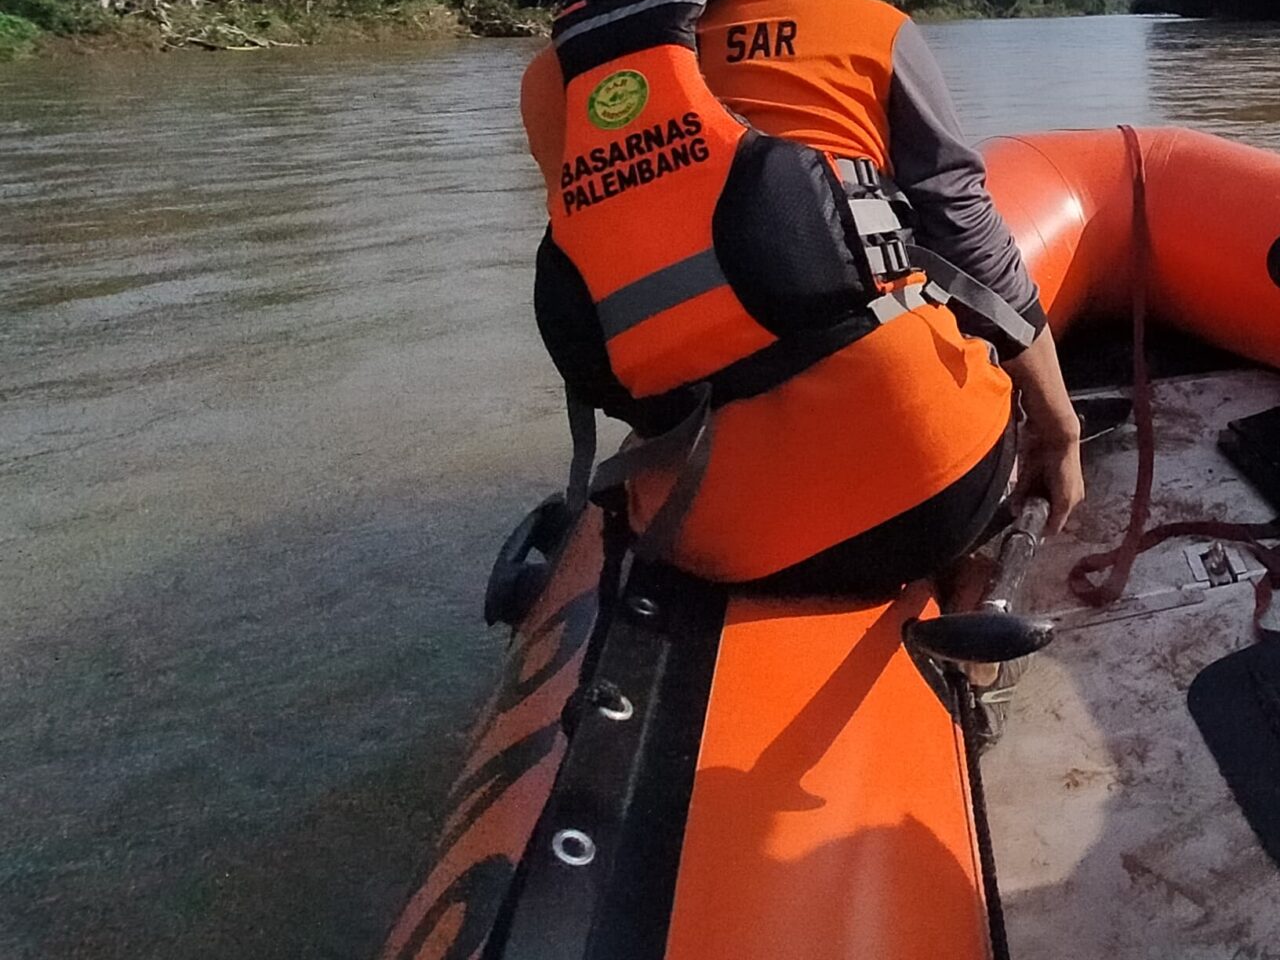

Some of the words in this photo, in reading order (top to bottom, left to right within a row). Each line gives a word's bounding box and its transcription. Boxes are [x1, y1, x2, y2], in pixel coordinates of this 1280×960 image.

[726, 20, 797, 63] SAR
[560, 111, 702, 189] BASARNAS
[562, 137, 710, 217] PALEMBANG
